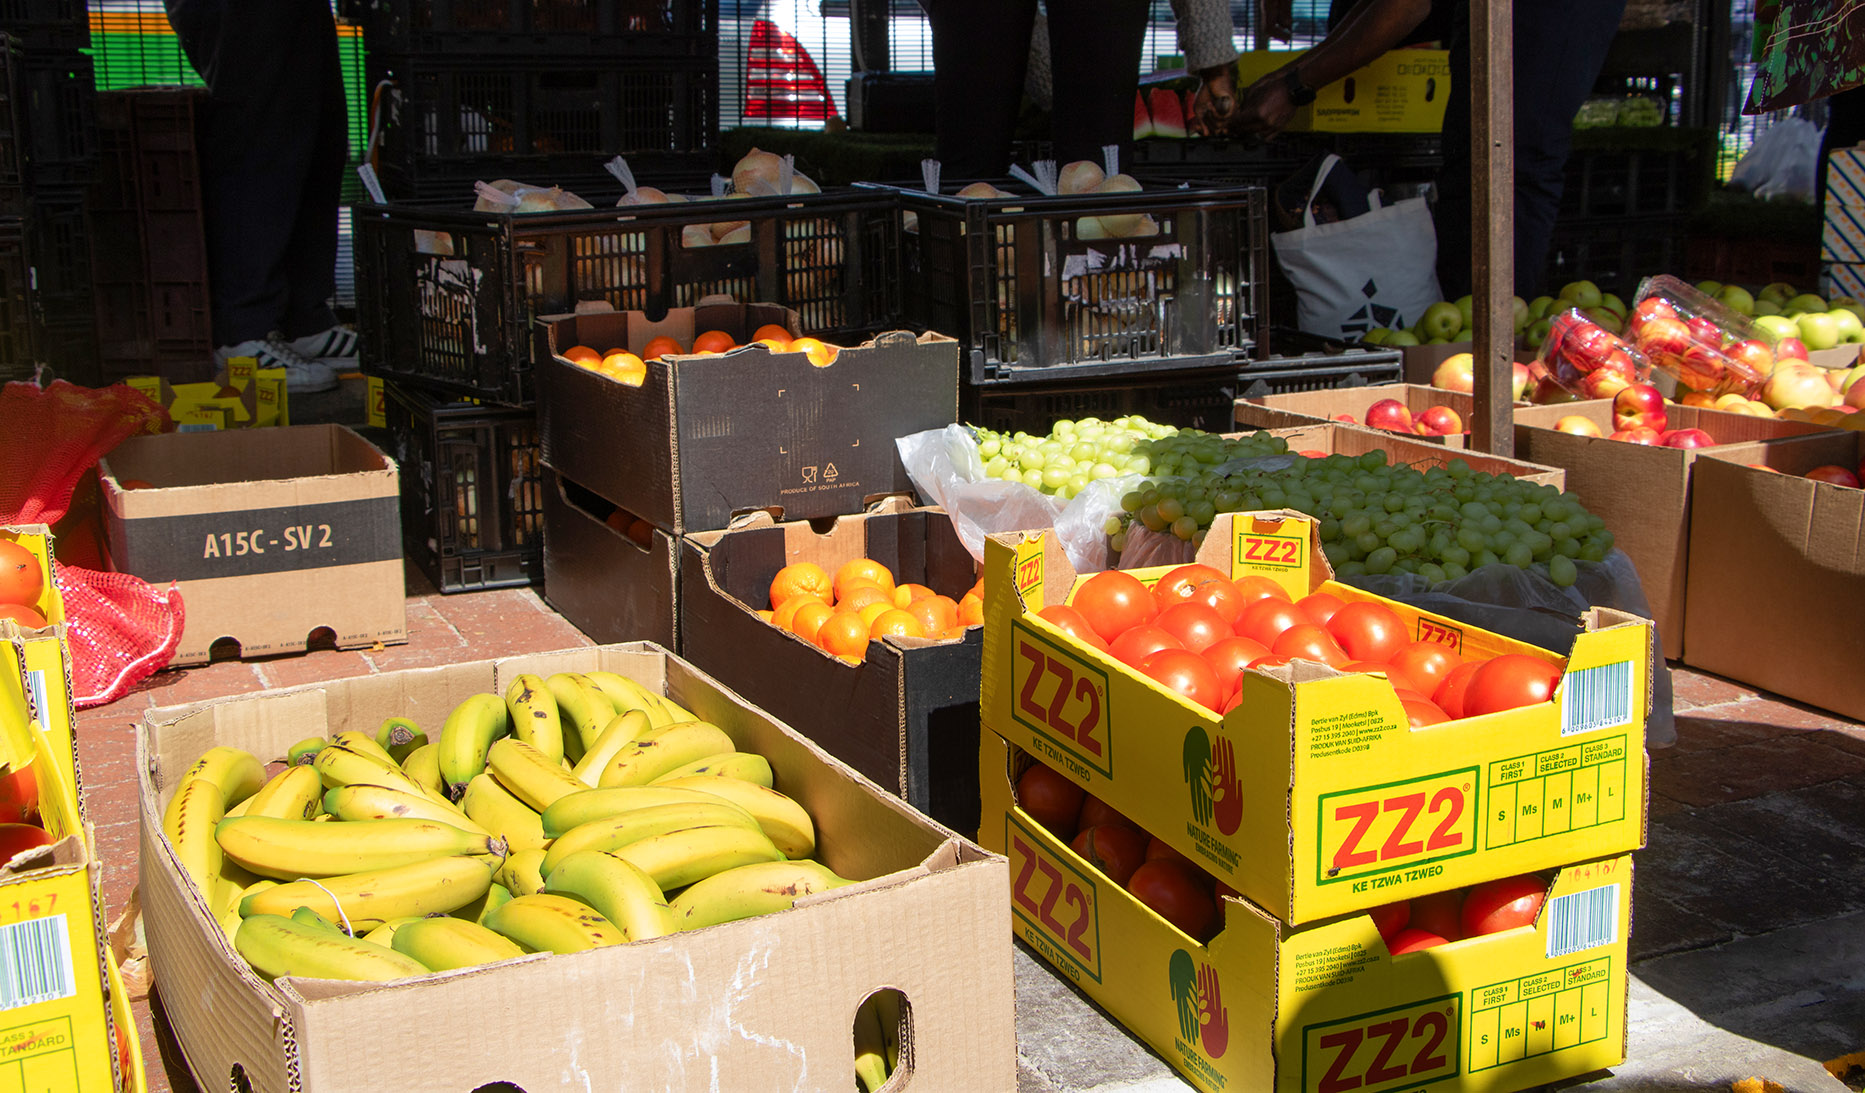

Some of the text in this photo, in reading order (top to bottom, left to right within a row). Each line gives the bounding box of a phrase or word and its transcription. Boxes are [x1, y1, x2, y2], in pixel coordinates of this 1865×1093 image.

[780, 487, 808, 495] PRODUCE
[839, 481, 860, 489] AFRICA
[203, 529, 265, 559] A15C
[284, 525, 313, 551] SV
[318, 524, 333, 548] 2
[1311, 726, 1331, 734] Posbus
[1310, 733, 1382, 751] PRODUK VAN SUID-AFRIKA
[1585, 745, 1603, 754] CLASS
[1032, 736, 1091, 782] KE TZWA TZWEO
[1540, 752, 1565, 764] CLASS 2
[1584, 747, 1623, 763] STANDARD
[1500, 762, 1520, 772] CLASS
[1540, 757, 1578, 773] SELECTED
[1500, 769, 1524, 781] FIRST
[1498, 787, 1614, 821] S Ms M M+ L
[1187, 821, 1211, 849] NATURE
[1352, 865, 1444, 894] KE TZWA TZWEO
[0, 893, 58, 921] 167
[1024, 927, 1081, 982] KE TZWA TZWEO
[1295, 975, 1319, 985] PRODUK
[1319, 972, 1331, 981] VAN
[1567, 969, 1606, 985] STANDARD
[1568, 967, 1587, 977] CLASS
[1523, 978, 1542, 988] CLASS
[1523, 980, 1561, 997] SELECTED
[1483, 988, 1503, 997] CLASS
[1483, 994, 1506, 1006] FIRST
[1481, 1007, 1598, 1045] S Ms M M+ L
[0, 1032, 26, 1045] ASS
[1175, 1036, 1198, 1066] NATURE
